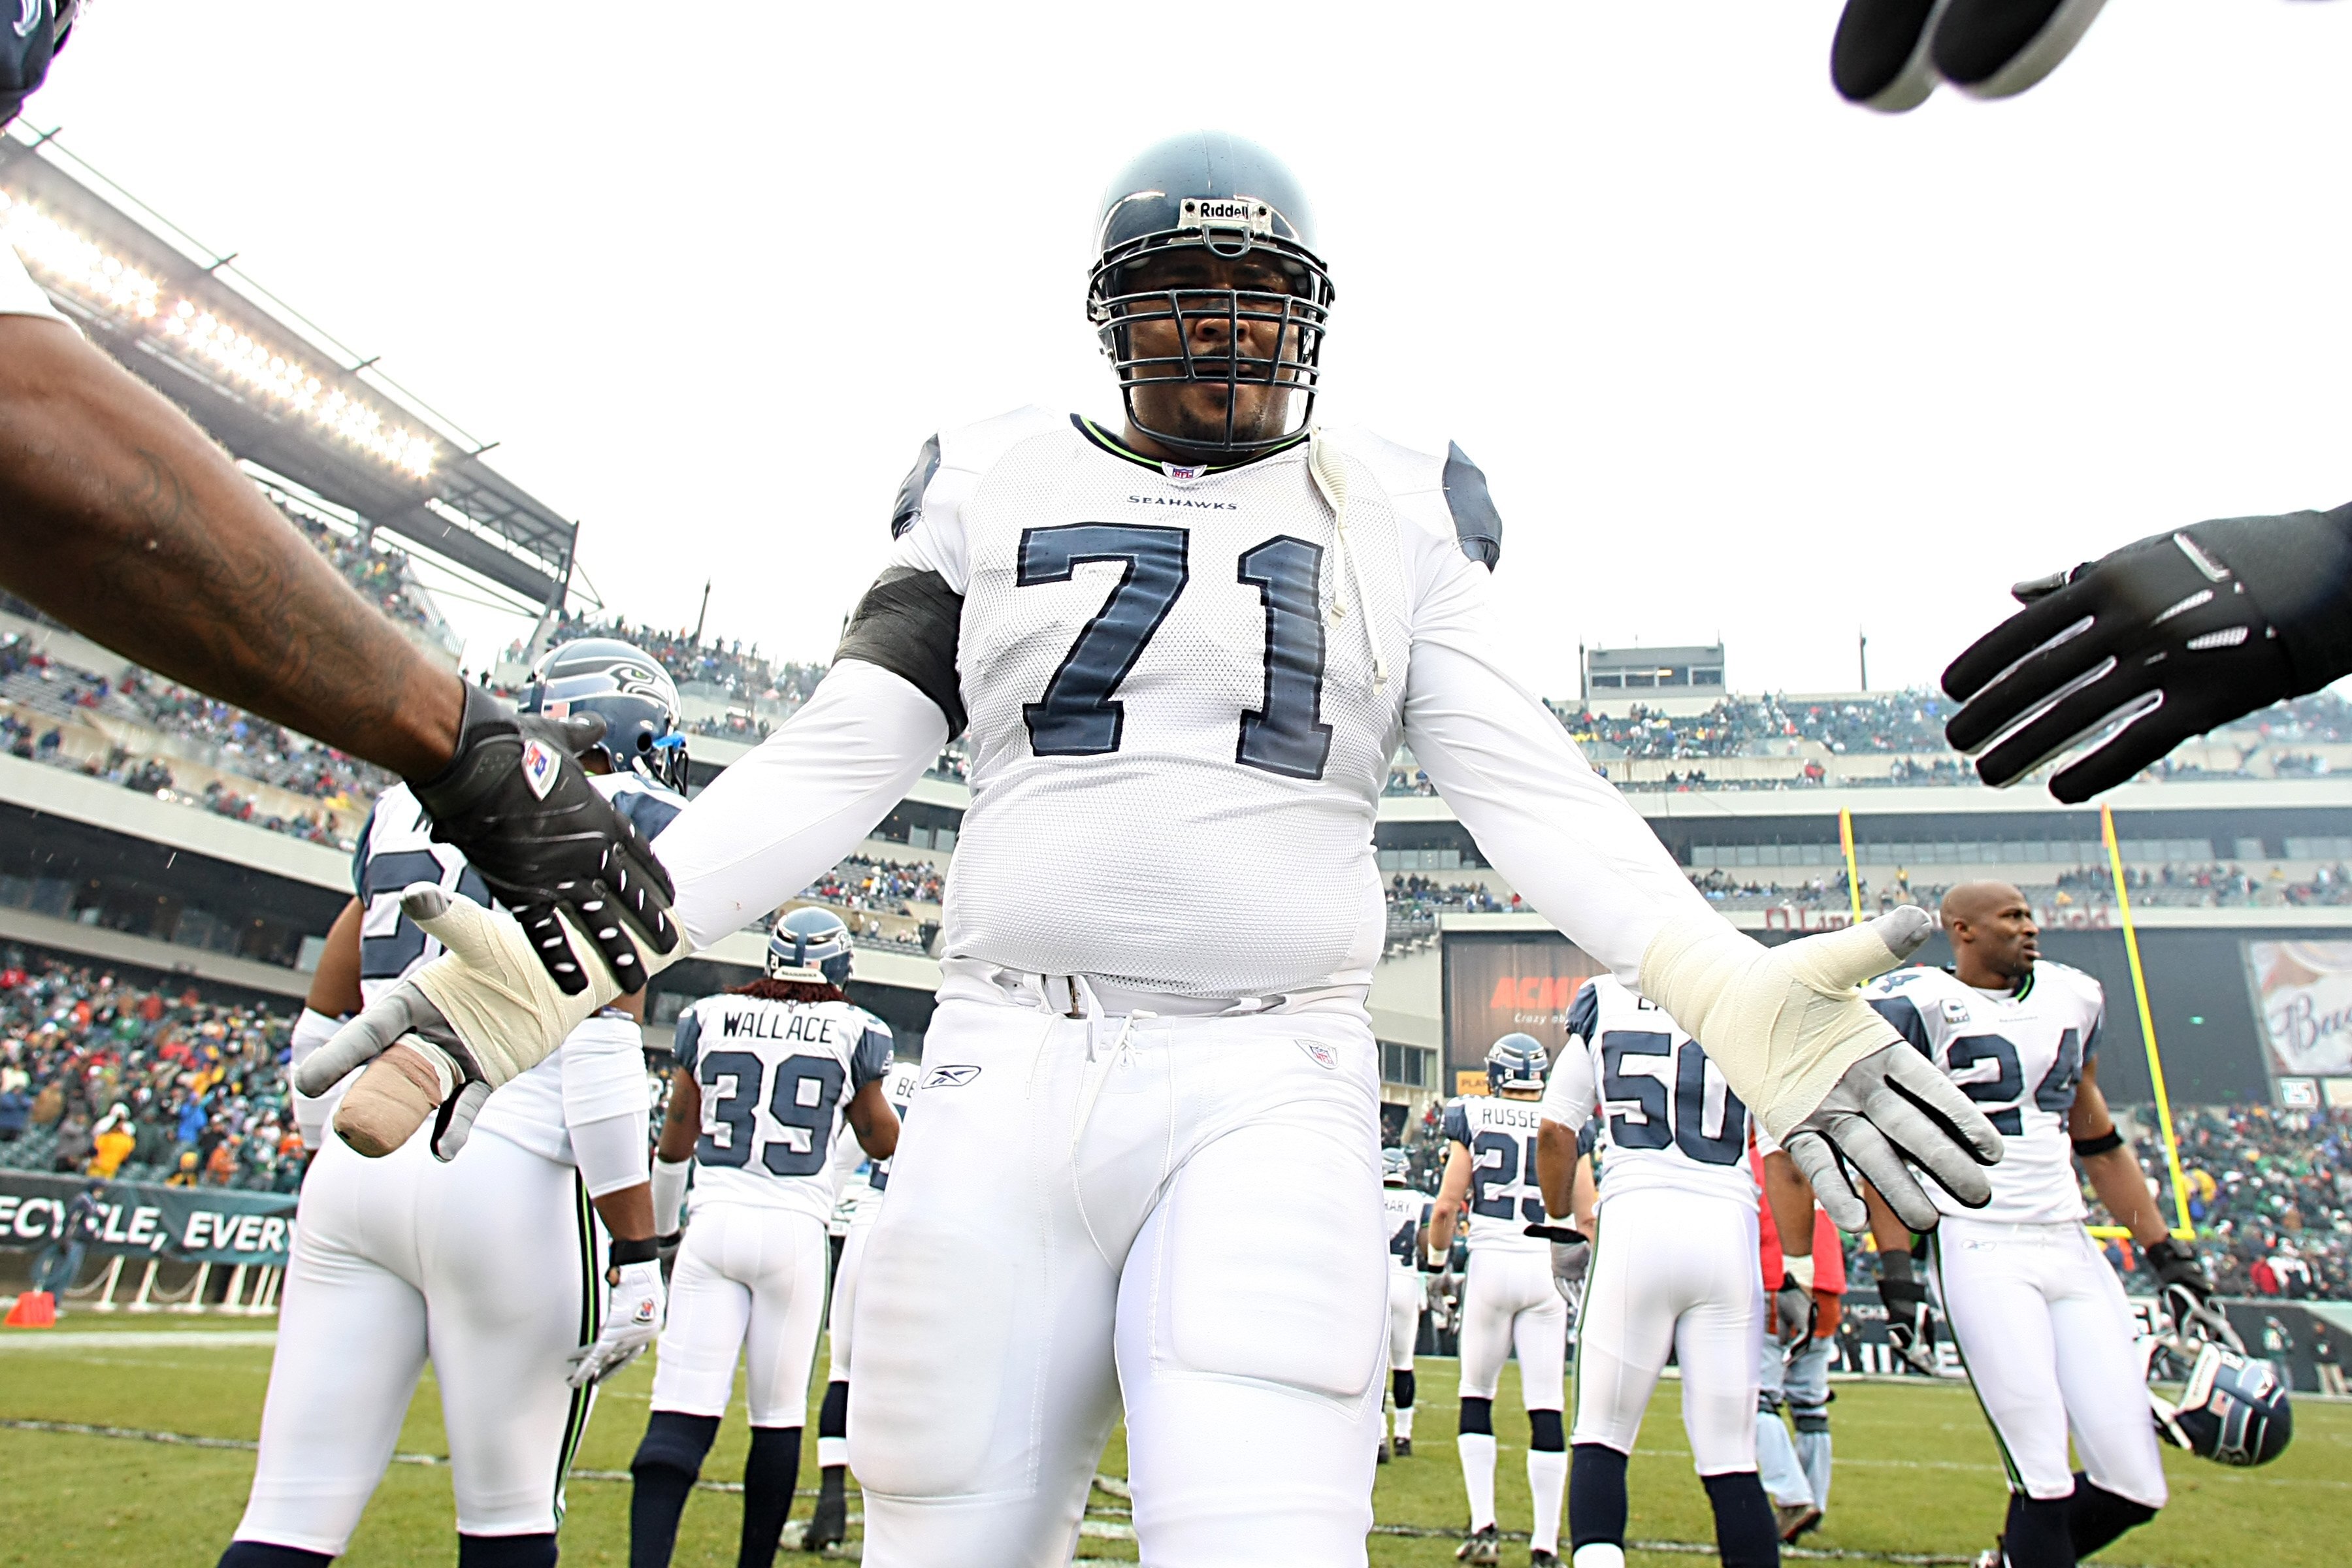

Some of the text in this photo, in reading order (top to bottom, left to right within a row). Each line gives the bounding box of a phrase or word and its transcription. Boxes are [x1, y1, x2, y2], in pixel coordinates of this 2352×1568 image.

[1200, 202, 1249, 220] Riddell
[1127, 495, 1237, 510] SEAHAWKS
[1017, 521, 1333, 780] 71
[723, 1012, 837, 1043] WALLACE
[696, 1051, 847, 1176] 39
[1601, 1030, 1746, 1166] 50
[1946, 1027, 2082, 1136] 24
[1482, 1108, 1540, 1129] RUSSE
